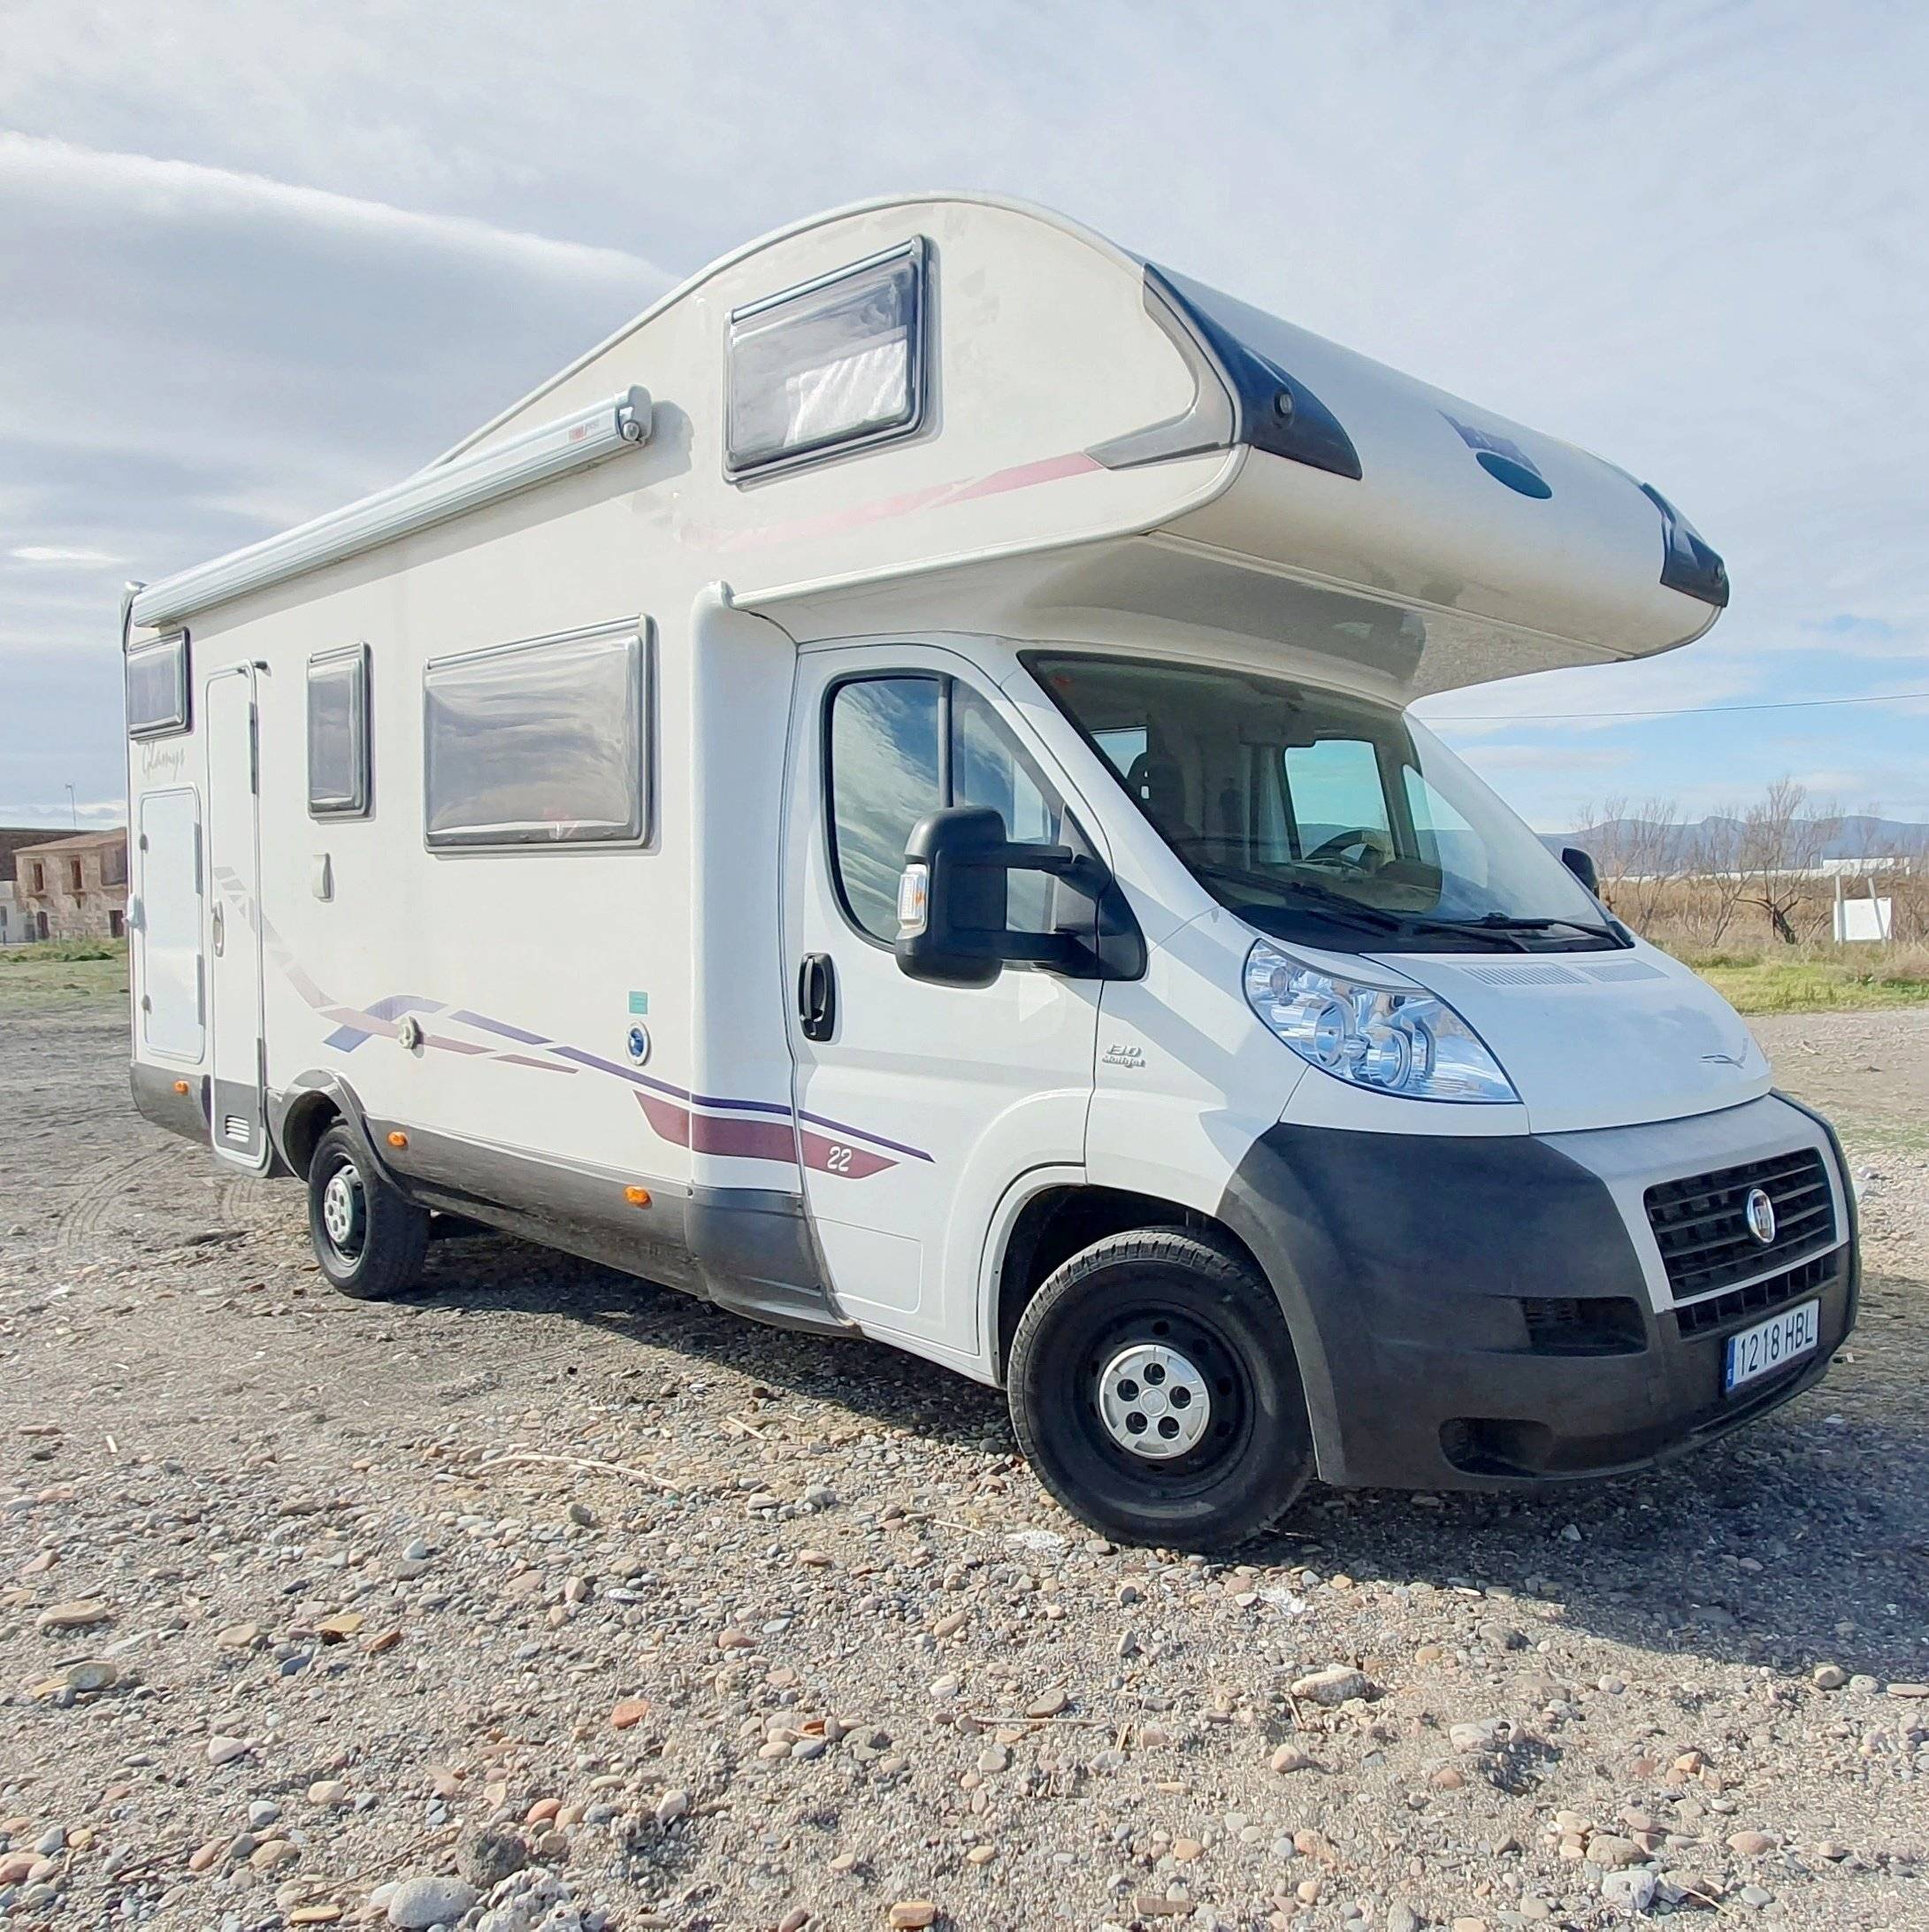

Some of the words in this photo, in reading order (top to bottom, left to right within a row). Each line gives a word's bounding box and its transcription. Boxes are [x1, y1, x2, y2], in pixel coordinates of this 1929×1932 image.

[827, 1146, 852, 1172] 22
[1741, 1323, 1780, 1376] 1218
[1785, 1309, 1813, 1354] HBL
